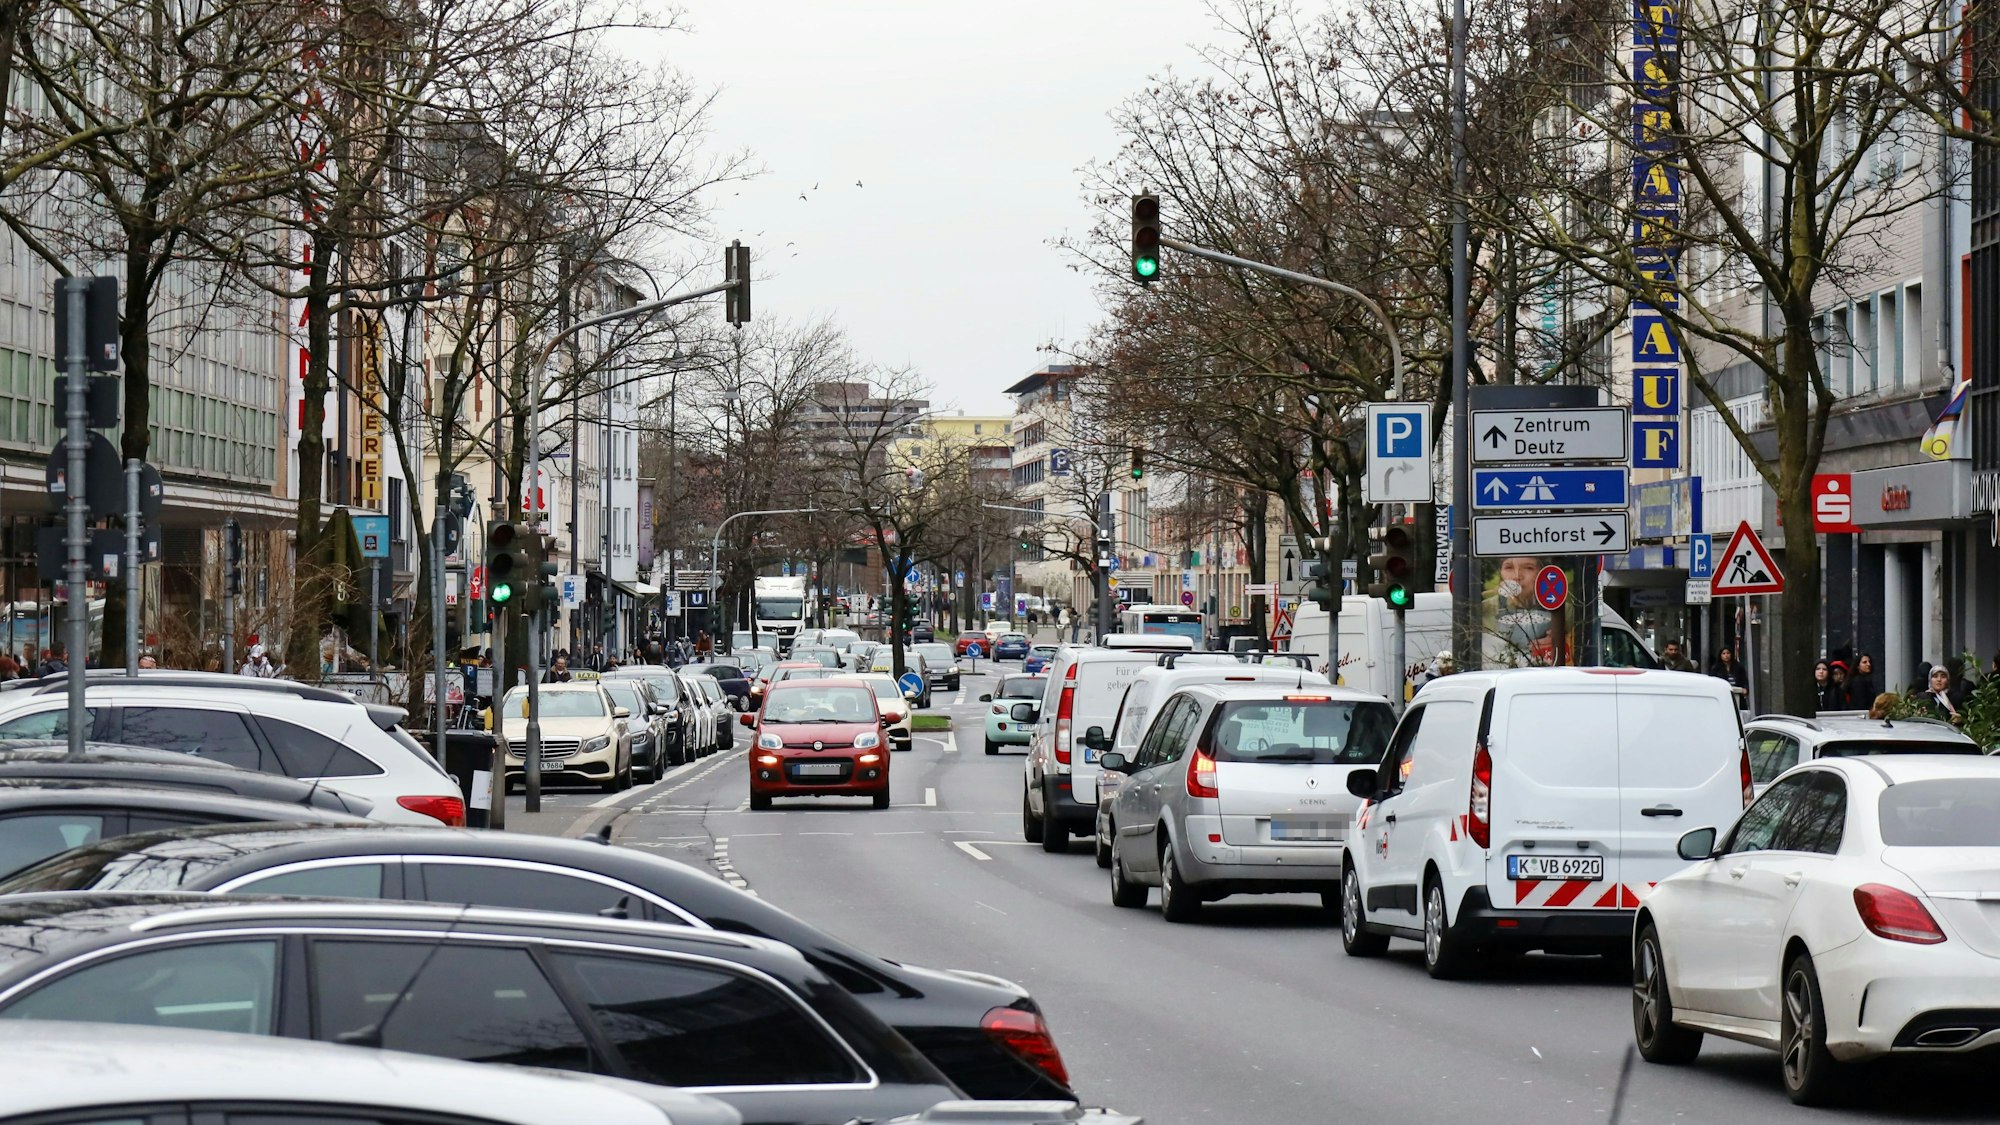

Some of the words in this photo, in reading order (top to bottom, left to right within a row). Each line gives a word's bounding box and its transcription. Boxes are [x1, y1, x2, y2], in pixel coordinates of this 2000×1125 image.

[1514, 417, 1590, 434] Zentrum
[1386, 417, 1412, 454] P
[1515, 439, 1565, 455] Deutz
[1500, 527, 1586, 544] Buchforst
[1694, 539, 1707, 572] P
[1115, 666, 1131, 676] Für
[1404, 662, 1427, 681] ips
[1091, 751, 1098, 759] K
[546, 761, 563, 769] 9684
[1519, 858, 1529, 874] K
[1539, 859, 1560, 874] VB
[1562, 859, 1600, 875] 6920
